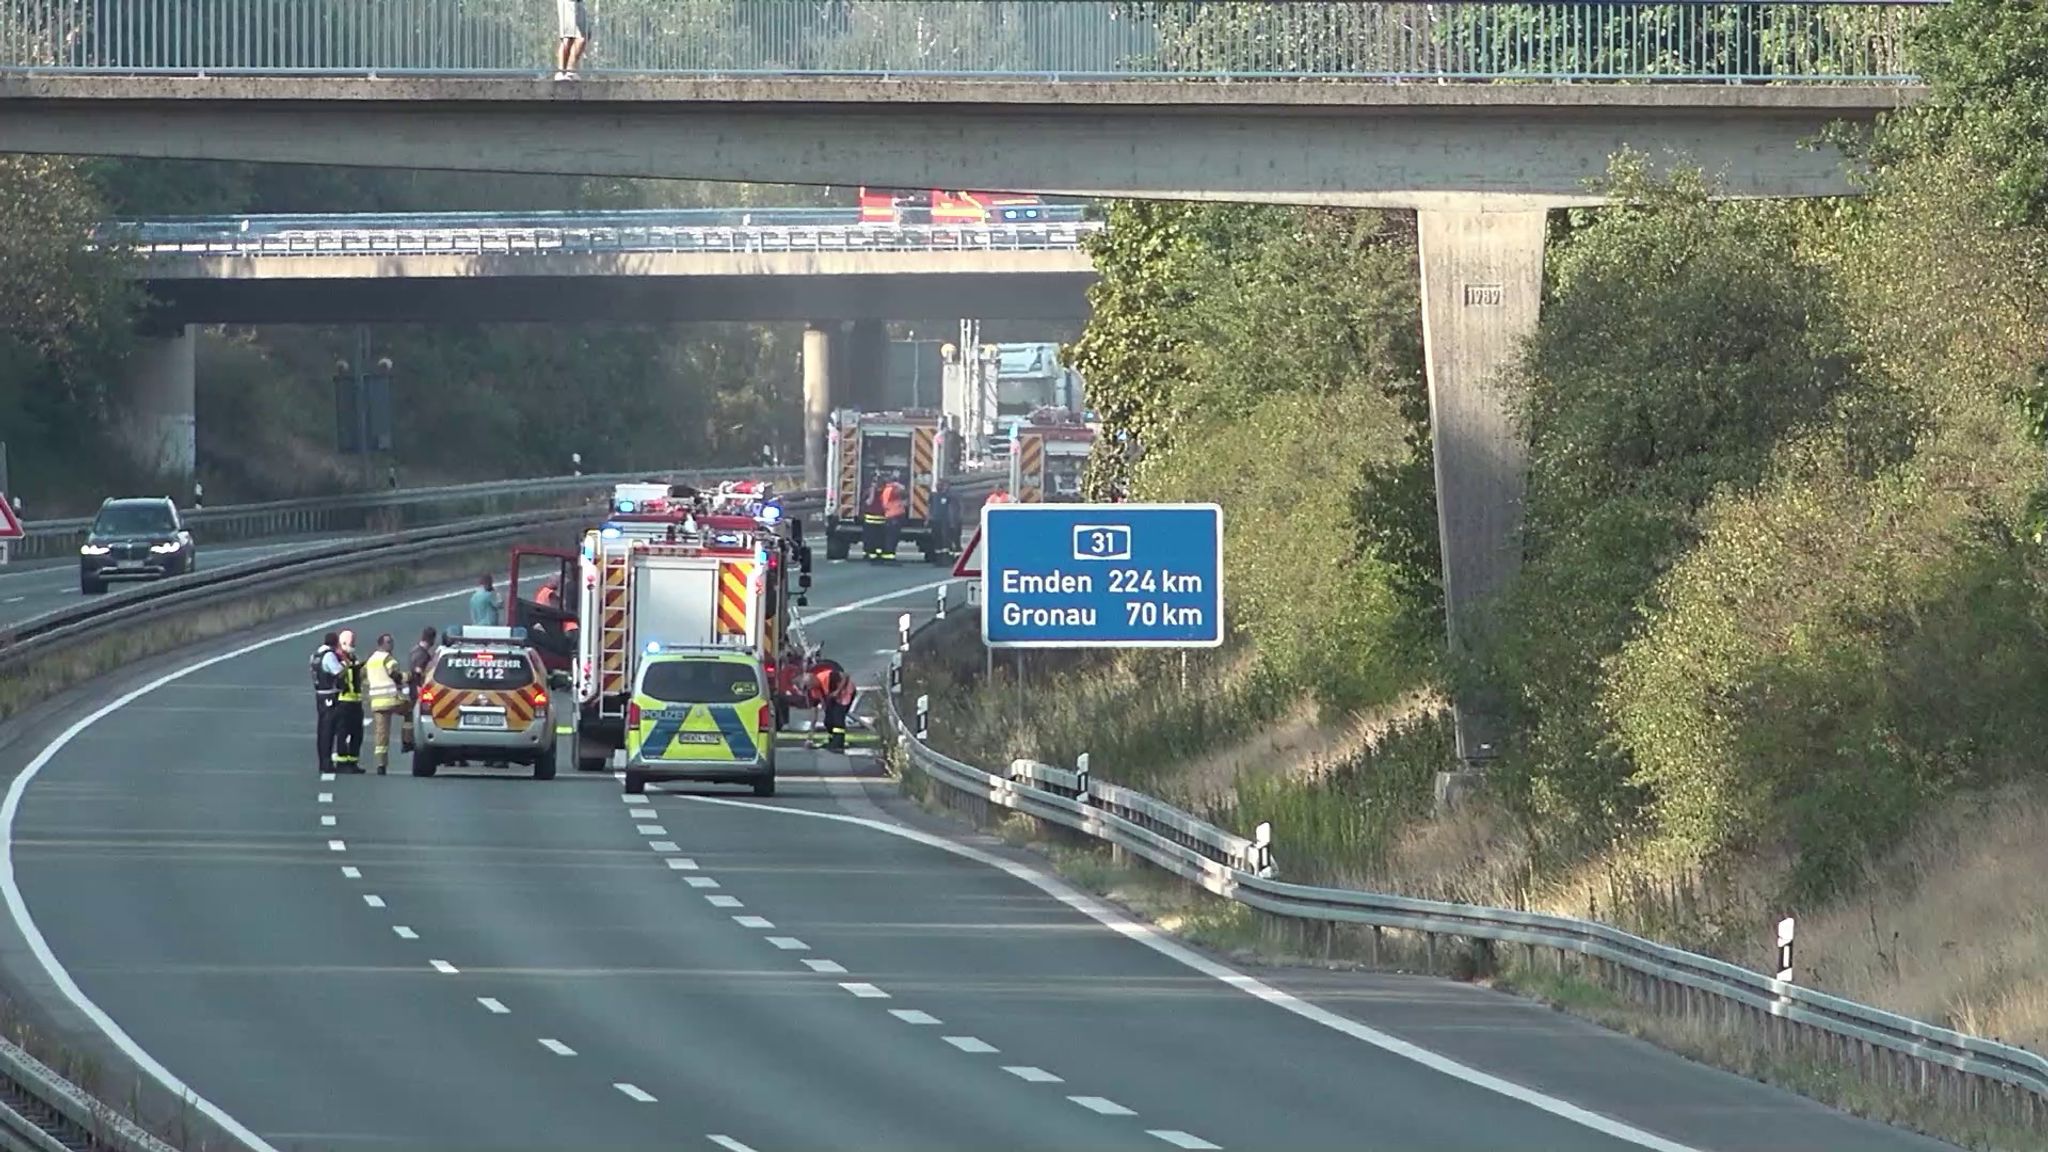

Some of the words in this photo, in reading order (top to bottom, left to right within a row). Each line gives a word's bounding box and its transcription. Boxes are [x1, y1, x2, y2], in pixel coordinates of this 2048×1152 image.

[1091, 532, 1114, 553] 31
[1002, 569, 1092, 593] Emden
[1108, 569, 1156, 593] 224
[1162, 569, 1202, 593] km
[1003, 602, 1097, 626] Gronau
[1126, 602, 1157, 626] 70
[1163, 602, 1203, 626] km
[447, 658, 521, 669] FEUERWEHR
[477, 668, 504, 680] 112
